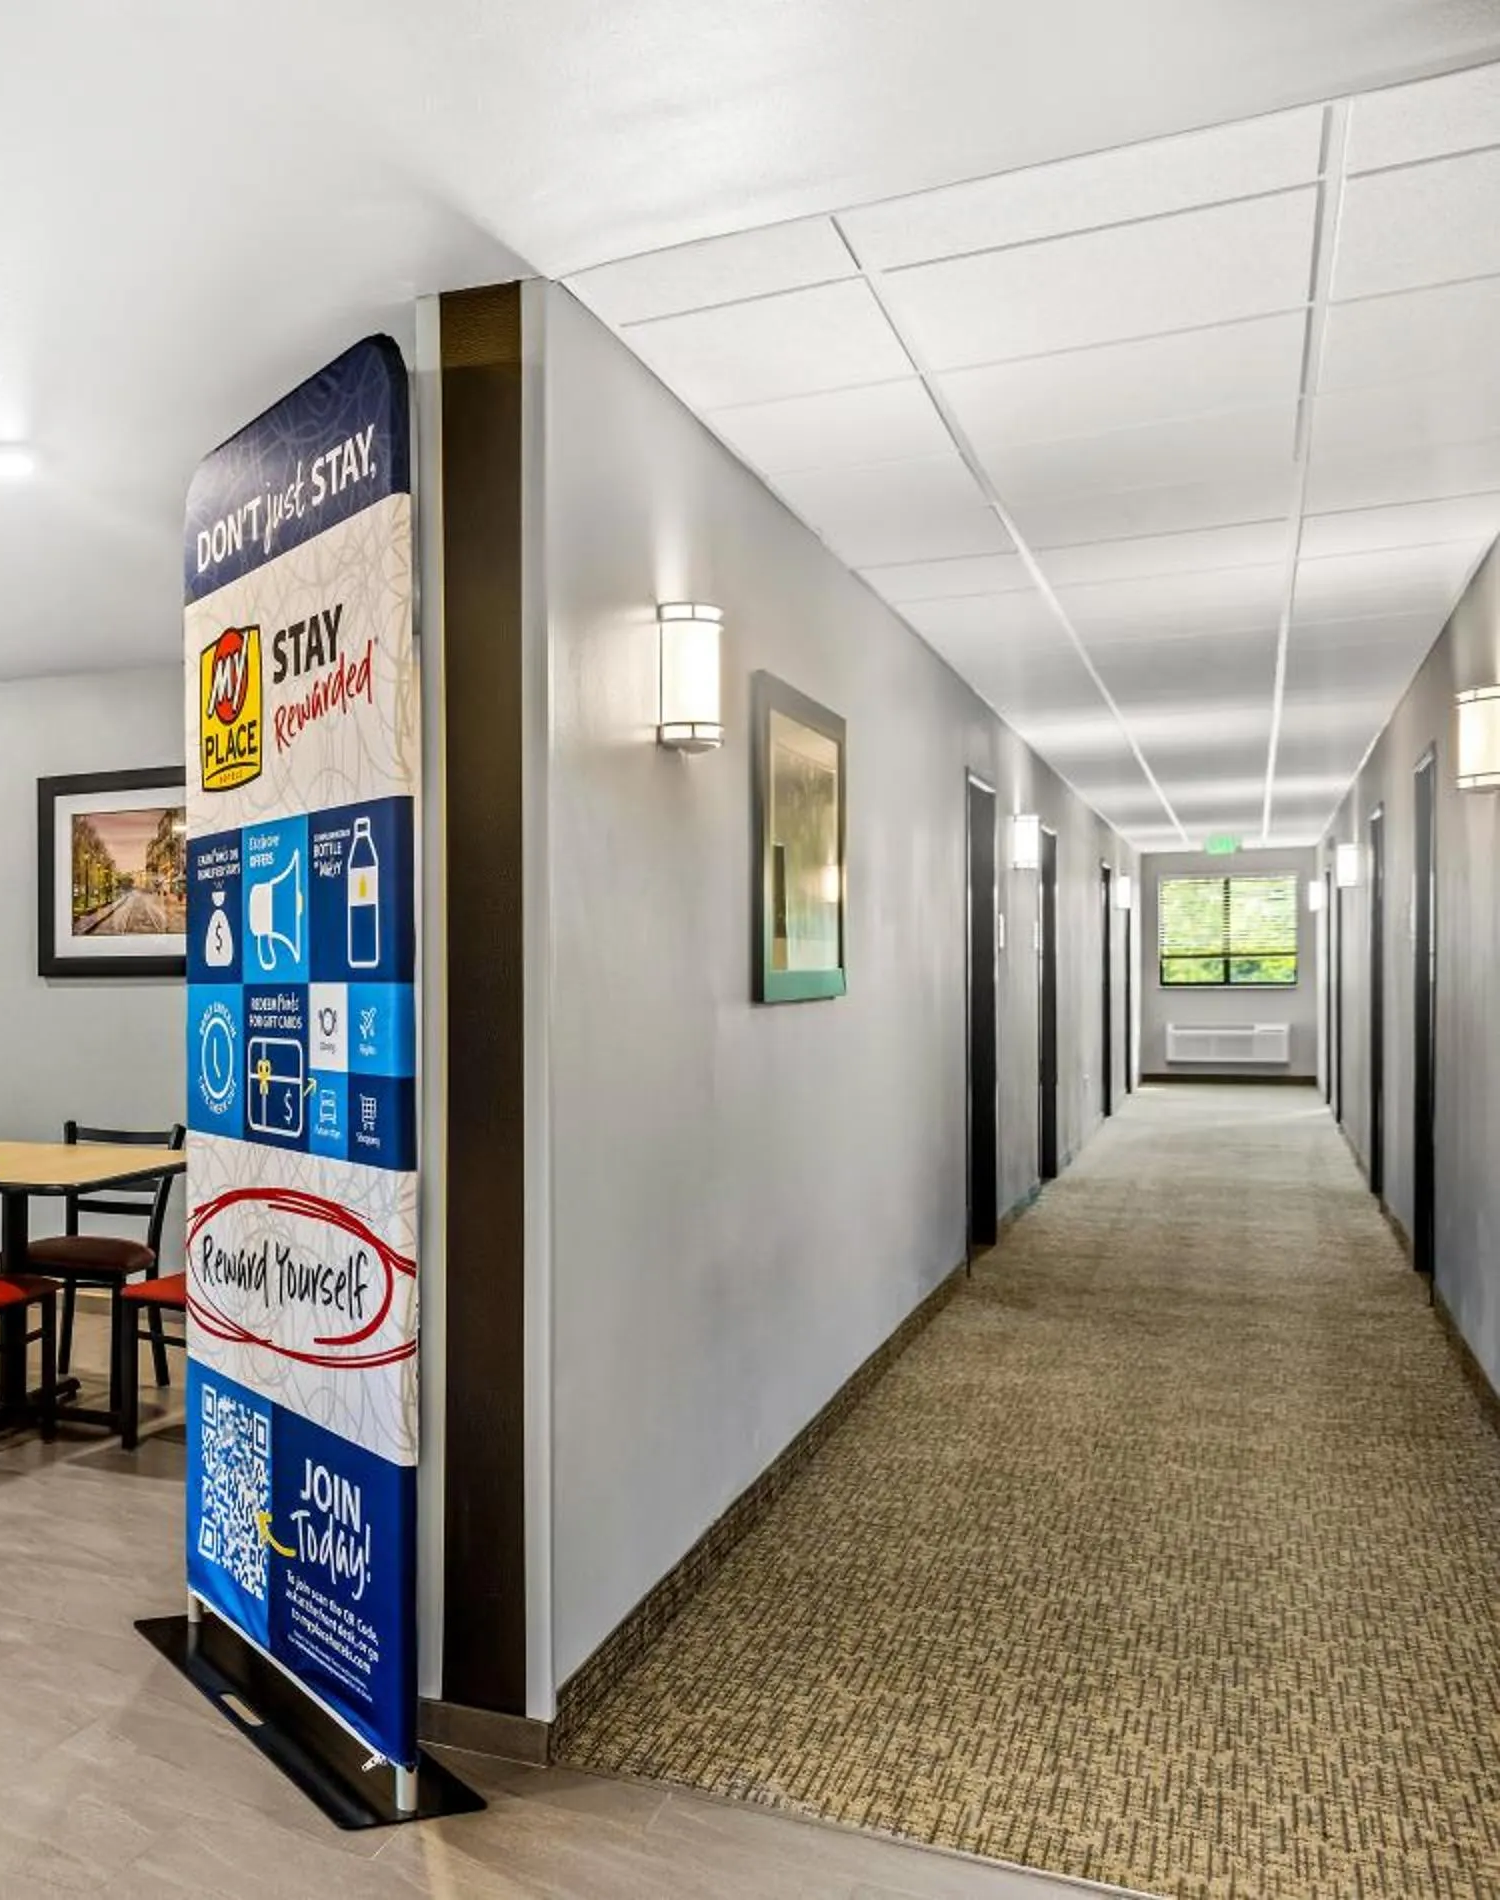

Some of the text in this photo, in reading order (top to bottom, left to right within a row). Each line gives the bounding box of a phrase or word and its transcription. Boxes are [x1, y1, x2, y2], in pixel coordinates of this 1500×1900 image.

[197, 496, 262, 573] DON'T
[263, 461, 305, 554] just
[207, 630, 249, 718] MY
[272, 604, 343, 685] STAY
[274, 639, 373, 754] Rewarded
[205, 720, 258, 768] PLACE
[202, 1235, 368, 1320] Reward Yourself
[300, 1457, 361, 1533] JOIN
[290, 1509, 371, 1600] Today!
